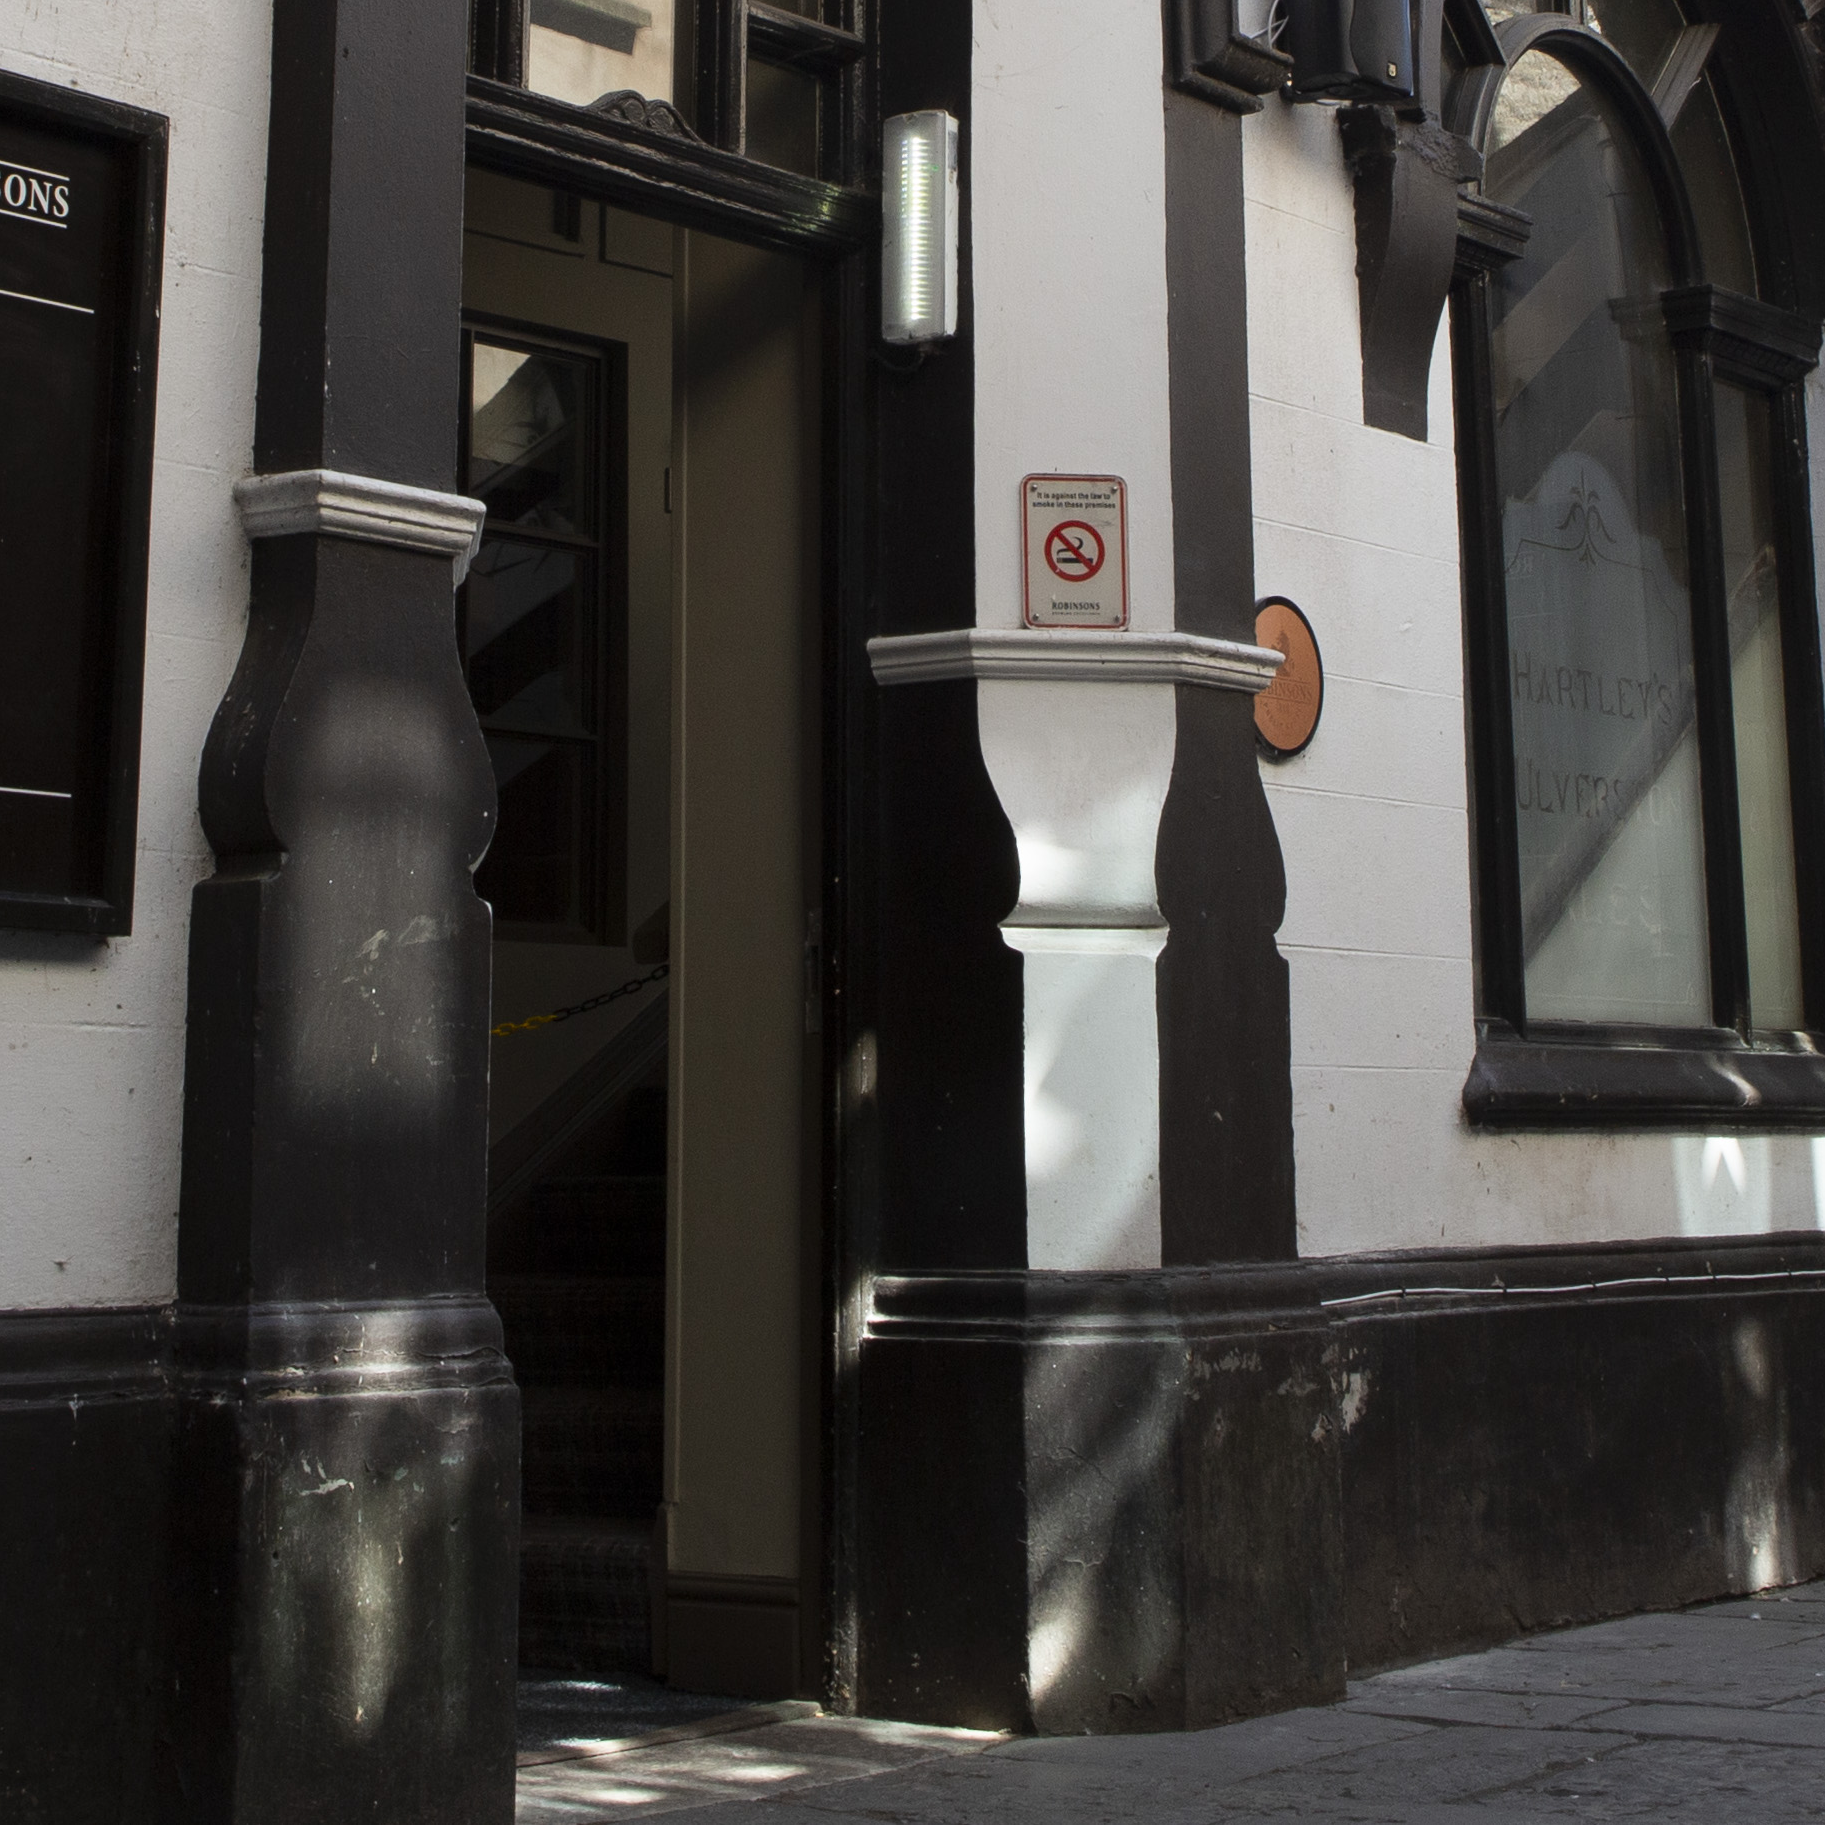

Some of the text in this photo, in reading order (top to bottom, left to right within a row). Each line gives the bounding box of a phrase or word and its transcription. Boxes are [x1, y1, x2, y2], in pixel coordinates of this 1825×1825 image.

[1051, 492, 1077, 500] against
[1078, 492, 1089, 500] the
[1090, 492, 1102, 500] law
[1085, 501, 1116, 510] premises
[1052, 601, 1100, 611] ROBINSONS
[1513, 652, 1675, 727] HARTLEY'S
